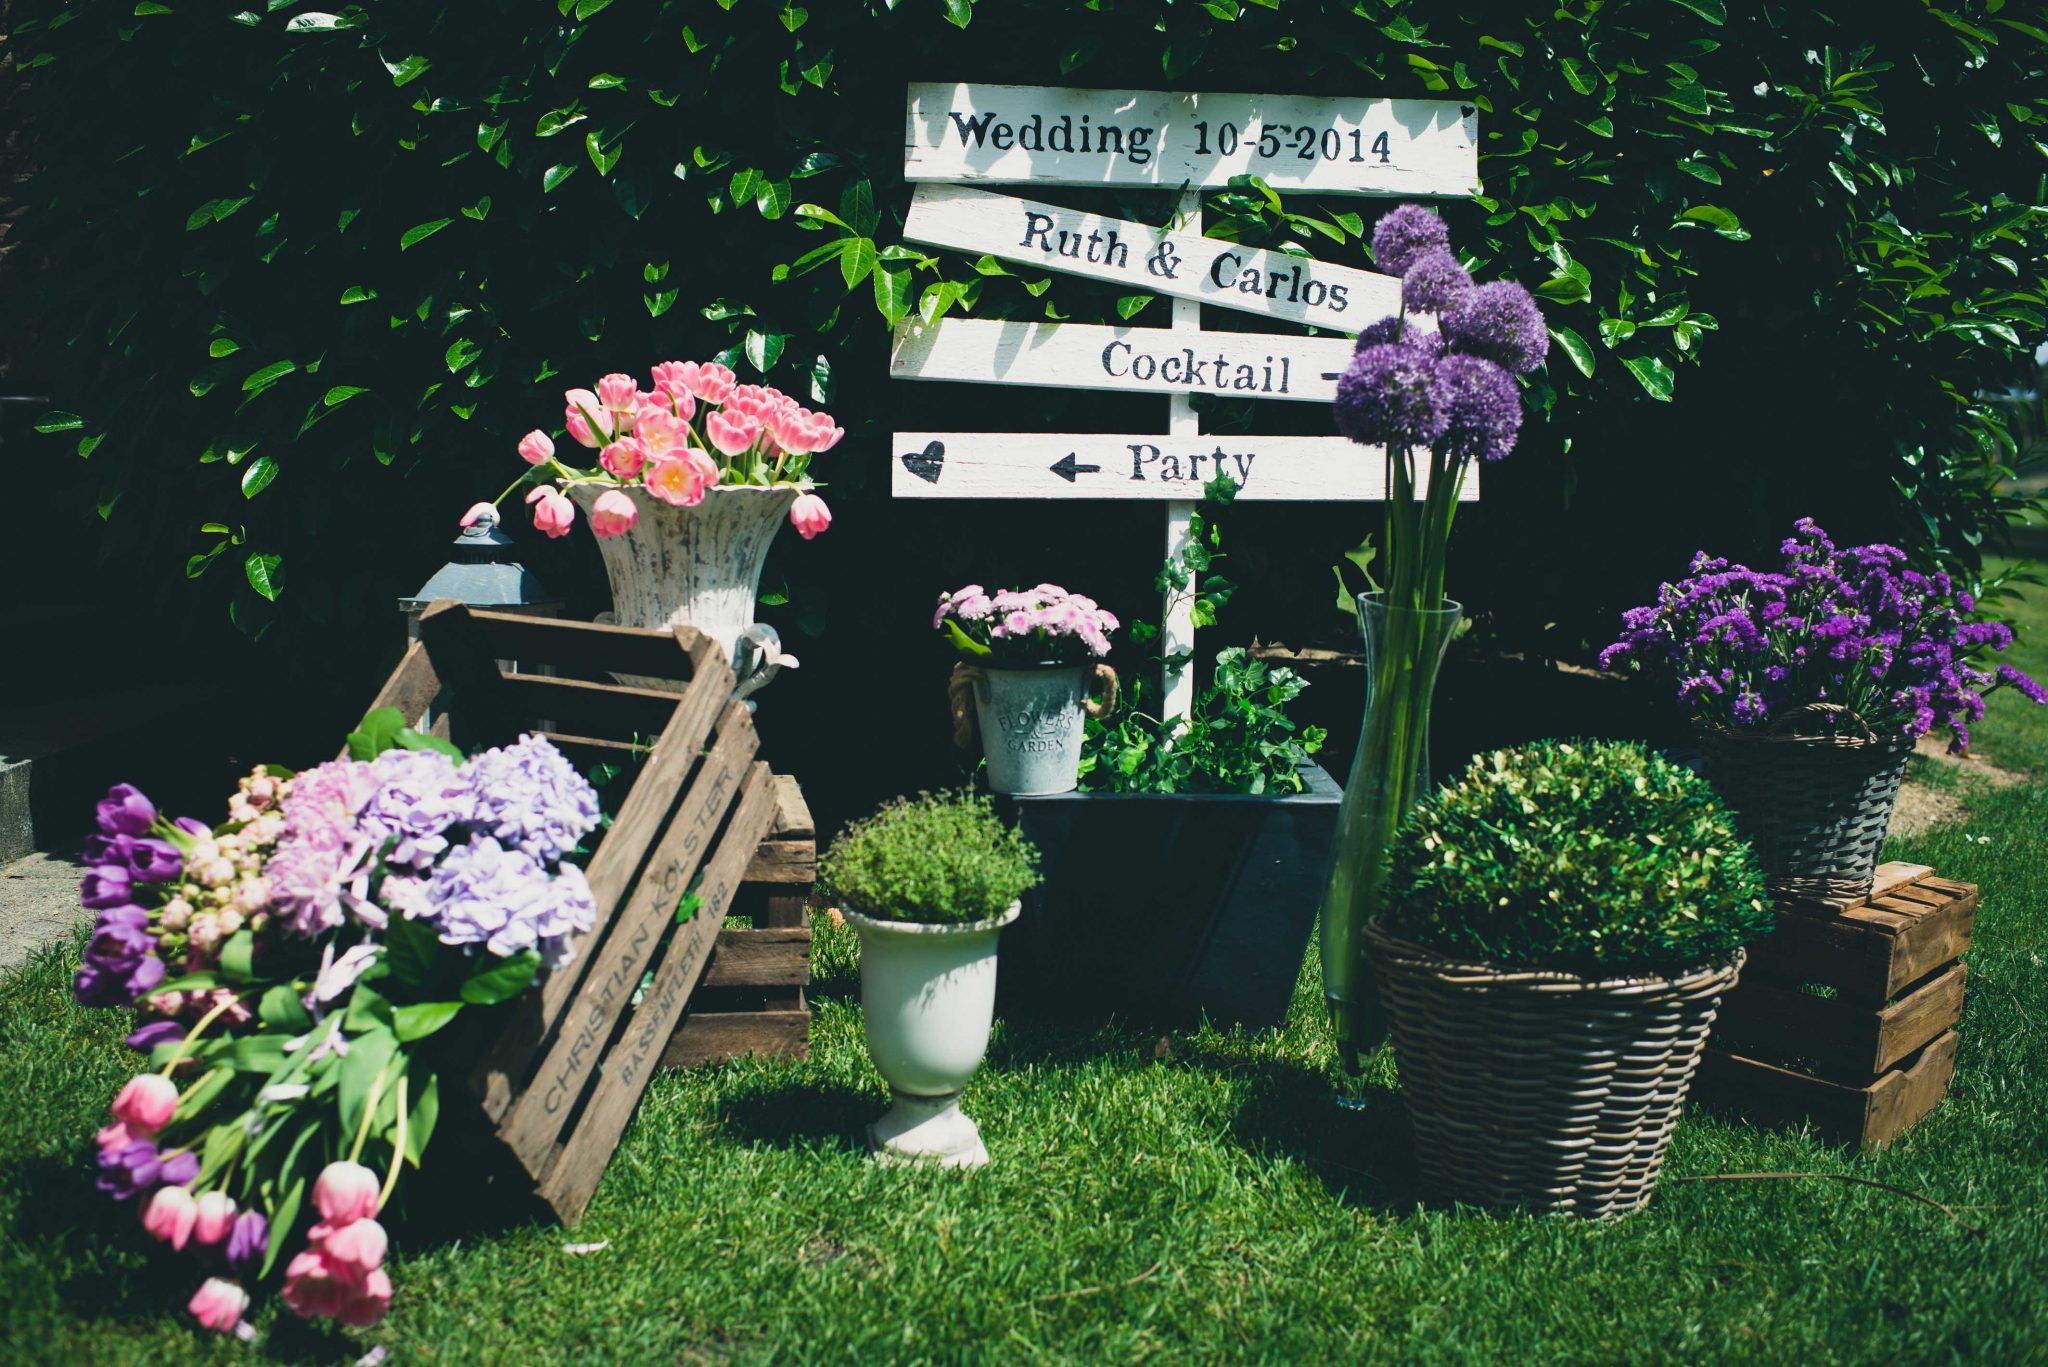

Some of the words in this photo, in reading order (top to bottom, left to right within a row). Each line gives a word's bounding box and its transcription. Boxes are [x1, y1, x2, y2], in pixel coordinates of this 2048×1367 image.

[949, 112, 1153, 163] Wedding
[1194, 122, 1391, 163] 10-5-2014
[1019, 211, 1129, 268] Ruth
[1148, 241, 1182, 279] &
[1210, 252, 1349, 312] Carlos
[1101, 341, 1290, 393] Cocktail
[1127, 443, 1256, 491] Party
[999, 711, 1073, 731] FLOWERS
[1008, 739, 1063, 752] GARDEN
[1031, 729, 1041, 739] &
[544, 927, 651, 1115] CHRISTIAN
